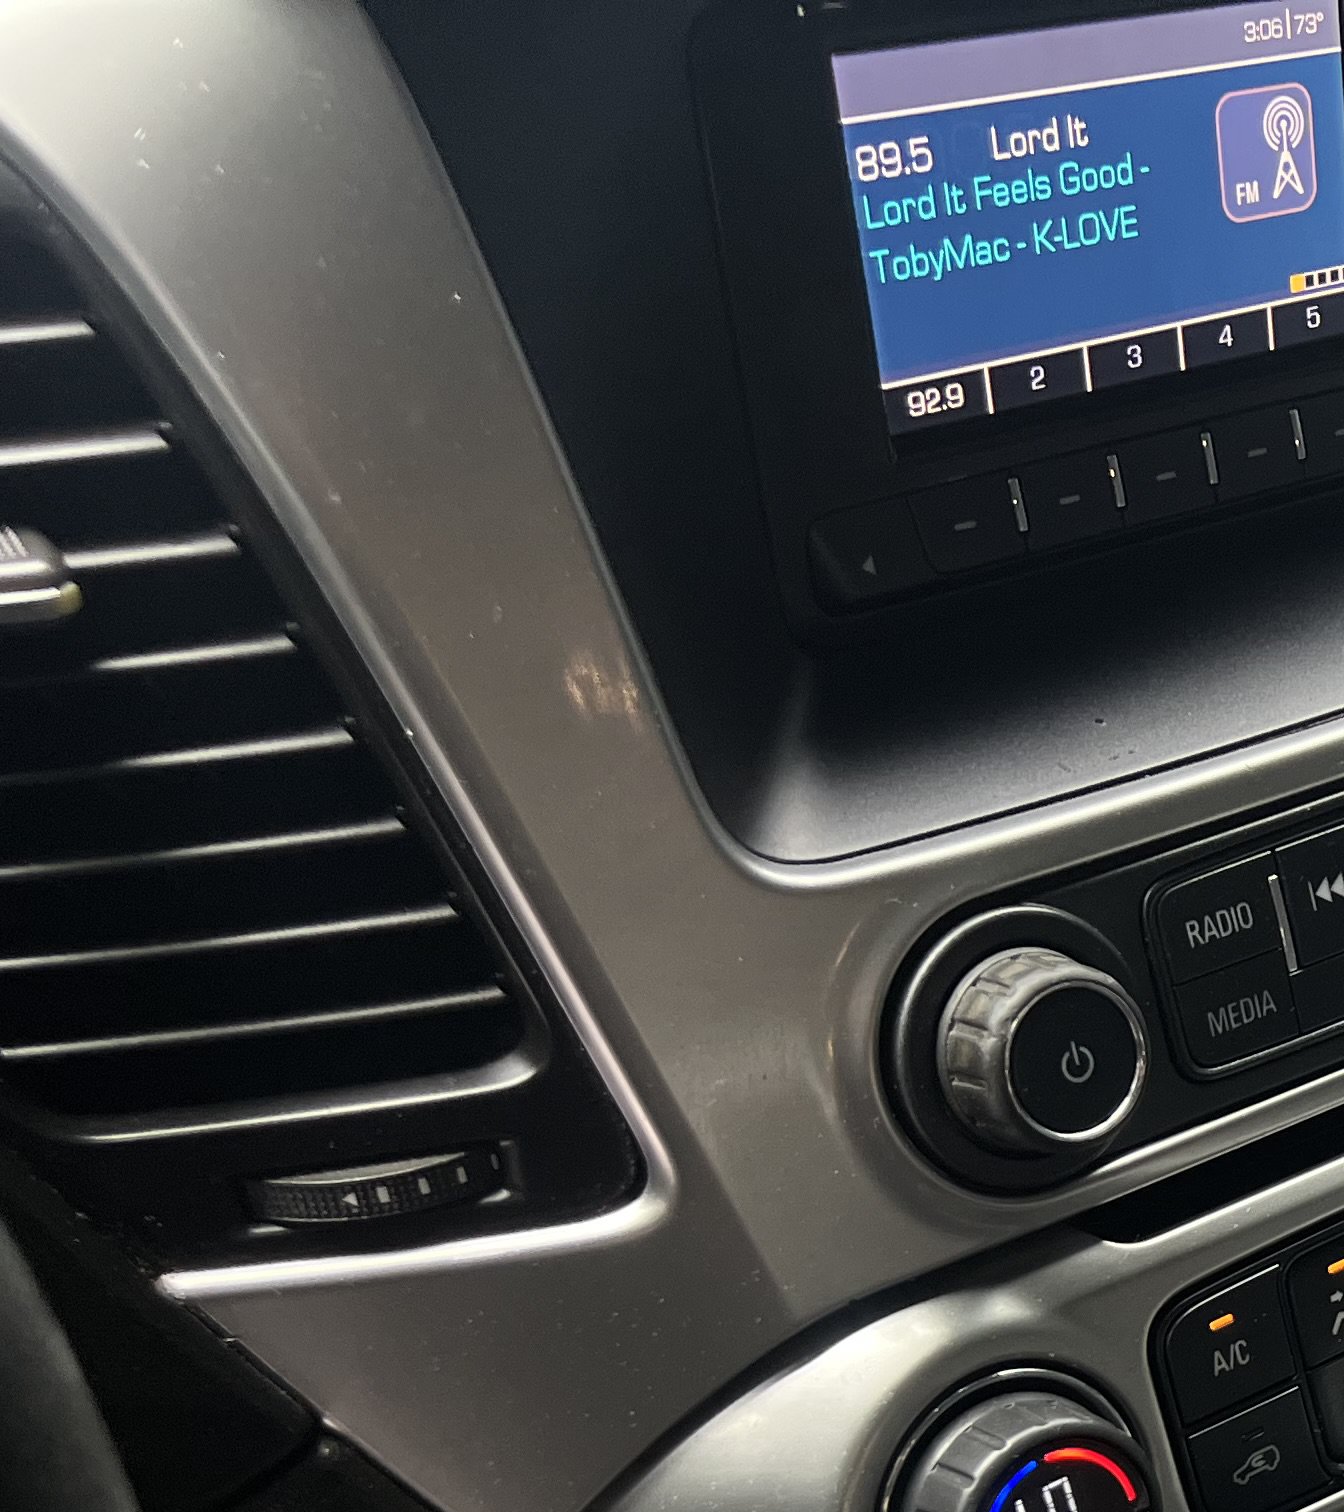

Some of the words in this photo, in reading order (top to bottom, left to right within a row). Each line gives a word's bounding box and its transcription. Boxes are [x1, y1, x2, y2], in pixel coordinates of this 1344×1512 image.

[1243, 18, 1284, 43] 3:06
[989, 116, 1060, 161] Lord
[1067, 114, 1090, 149] It
[855, 136, 934, 183] 89.5
[862, 184, 937, 230] Lord
[943, 181, 967, 216] It
[973, 168, 1052, 210] Feels
[1059, 151, 1134, 196] Good
[1235, 180, 1260, 206] FM
[869, 233, 1012, 284] TobyMac
[1033, 205, 1140, 254] K-LOVE
[1305, 305, 1321, 329] 5
[1218, 324, 1235, 348] 4
[1126, 344, 1143, 369] 3
[1029, 365, 1047, 391] 2
[906, 382, 965, 418] 92.9
[1184, 901, 1254, 950] RADIO
[1207, 989, 1278, 1038] MEDIA
[1213, 1339, 1250, 1377] A/C
